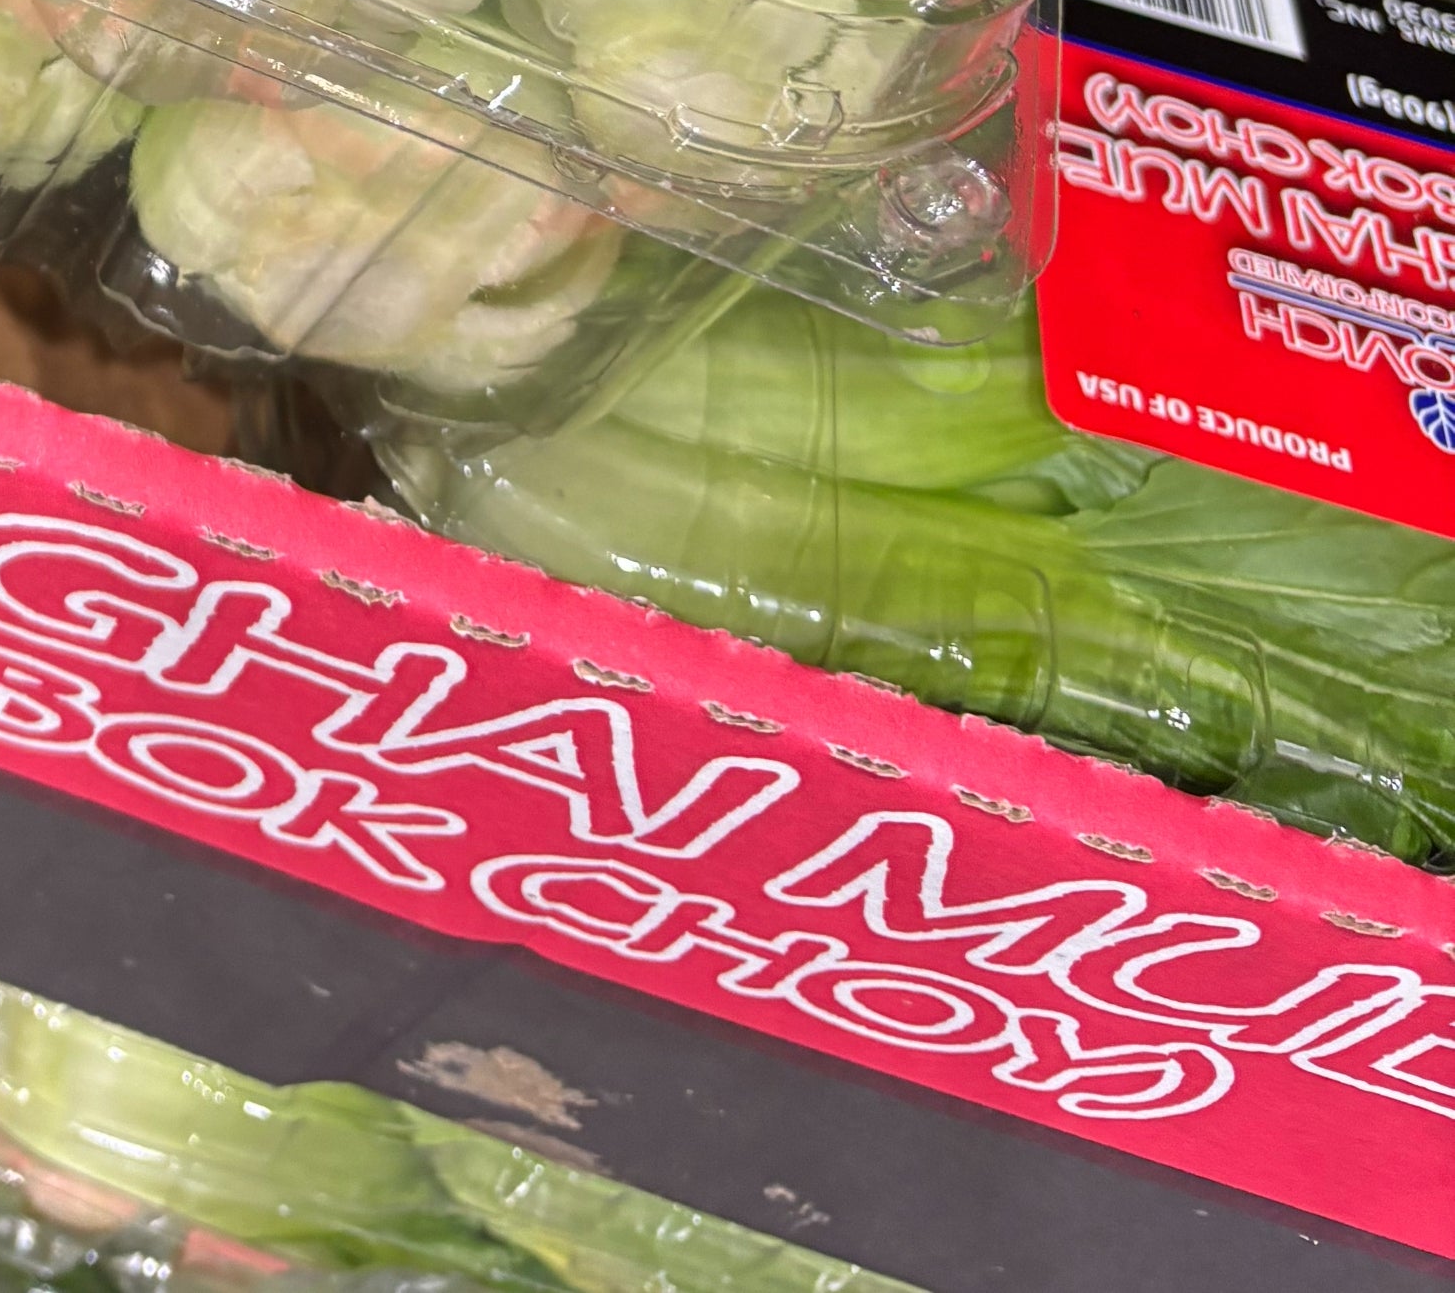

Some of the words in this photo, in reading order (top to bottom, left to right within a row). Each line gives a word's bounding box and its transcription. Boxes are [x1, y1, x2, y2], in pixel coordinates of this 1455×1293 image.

[1083, 70, 1313, 178] CHOY)
[1043, 119, 1274, 238] MUE
[1074, 368, 1144, 414] USA
[1148, 391, 1195, 424] OF
[1195, 403, 1354, 473] PRODUCE
[469, 854, 1238, 1121] CHOY)
